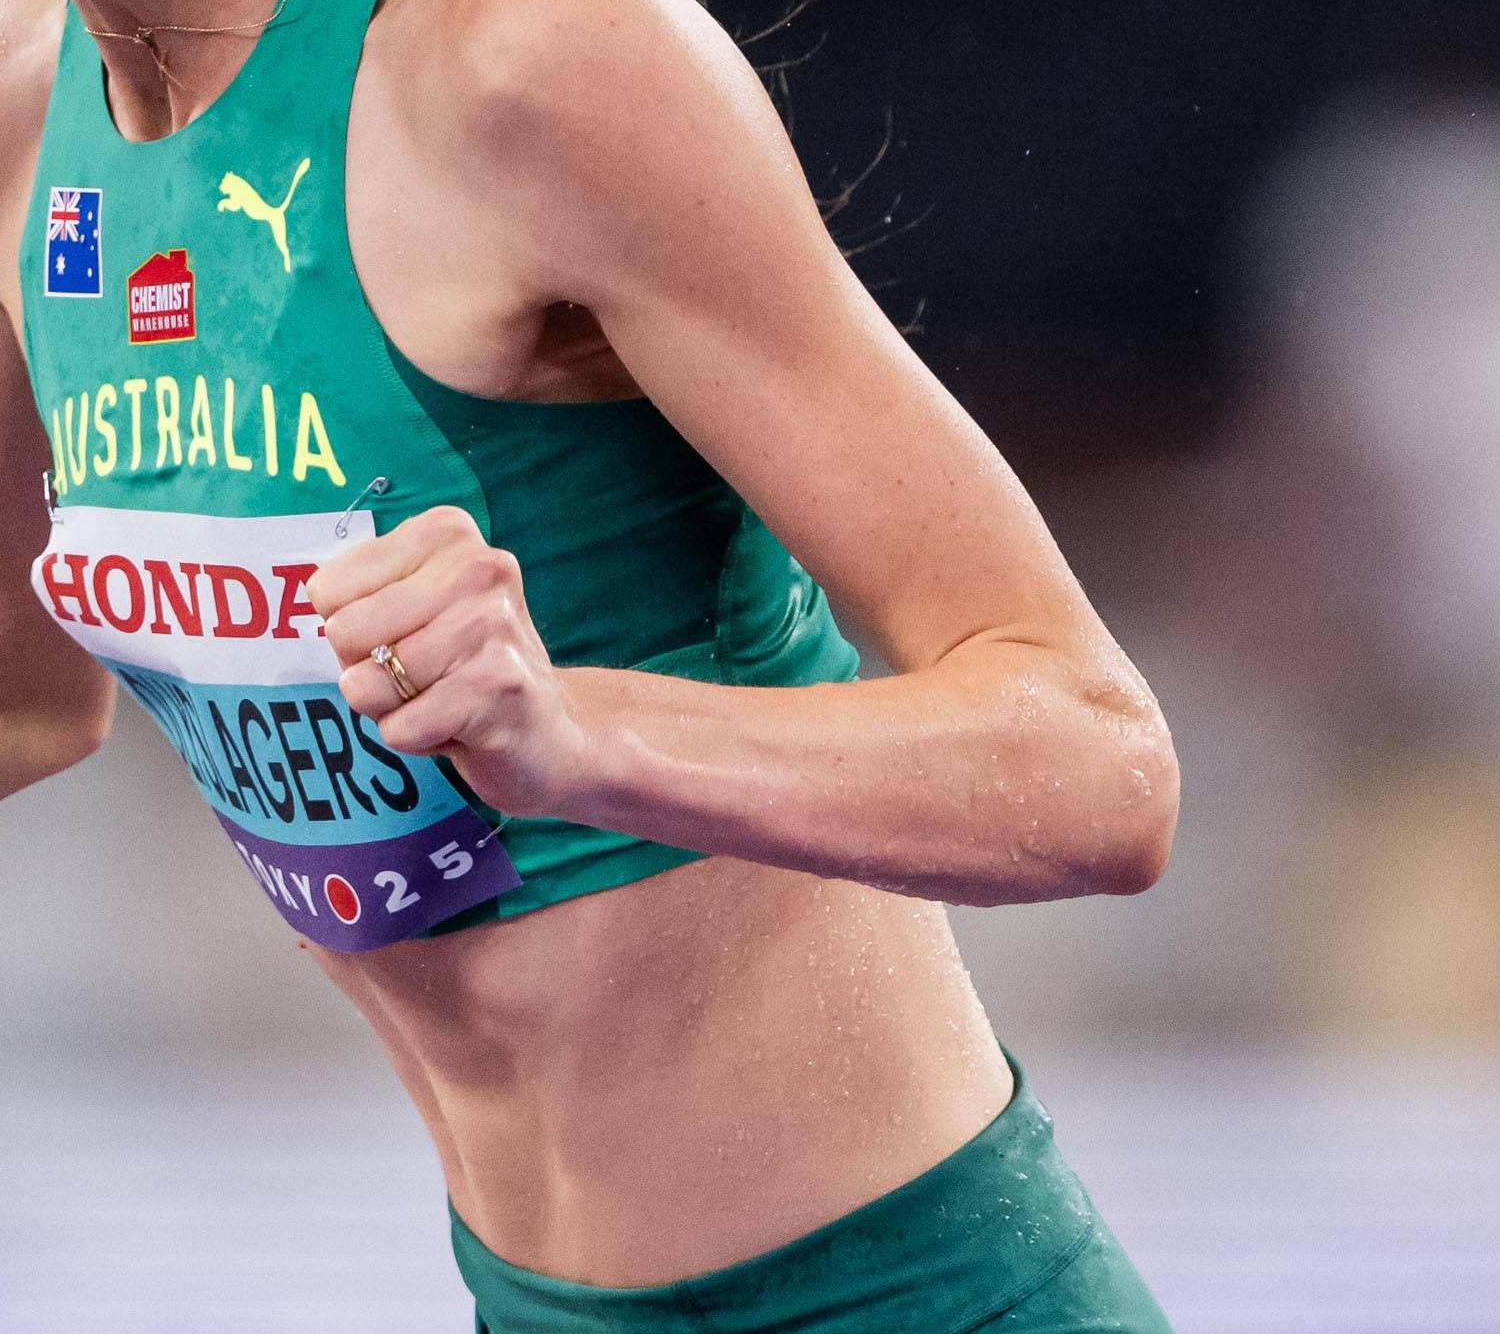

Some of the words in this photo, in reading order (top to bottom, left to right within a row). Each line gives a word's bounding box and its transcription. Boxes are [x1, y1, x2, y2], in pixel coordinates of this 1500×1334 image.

[131, 282, 191, 315] CHEMIST
[132, 314, 190, 332] WAREHOUSE
[52, 375, 347, 496] AUSTRALIA
[42, 553, 326, 639] HONDA
